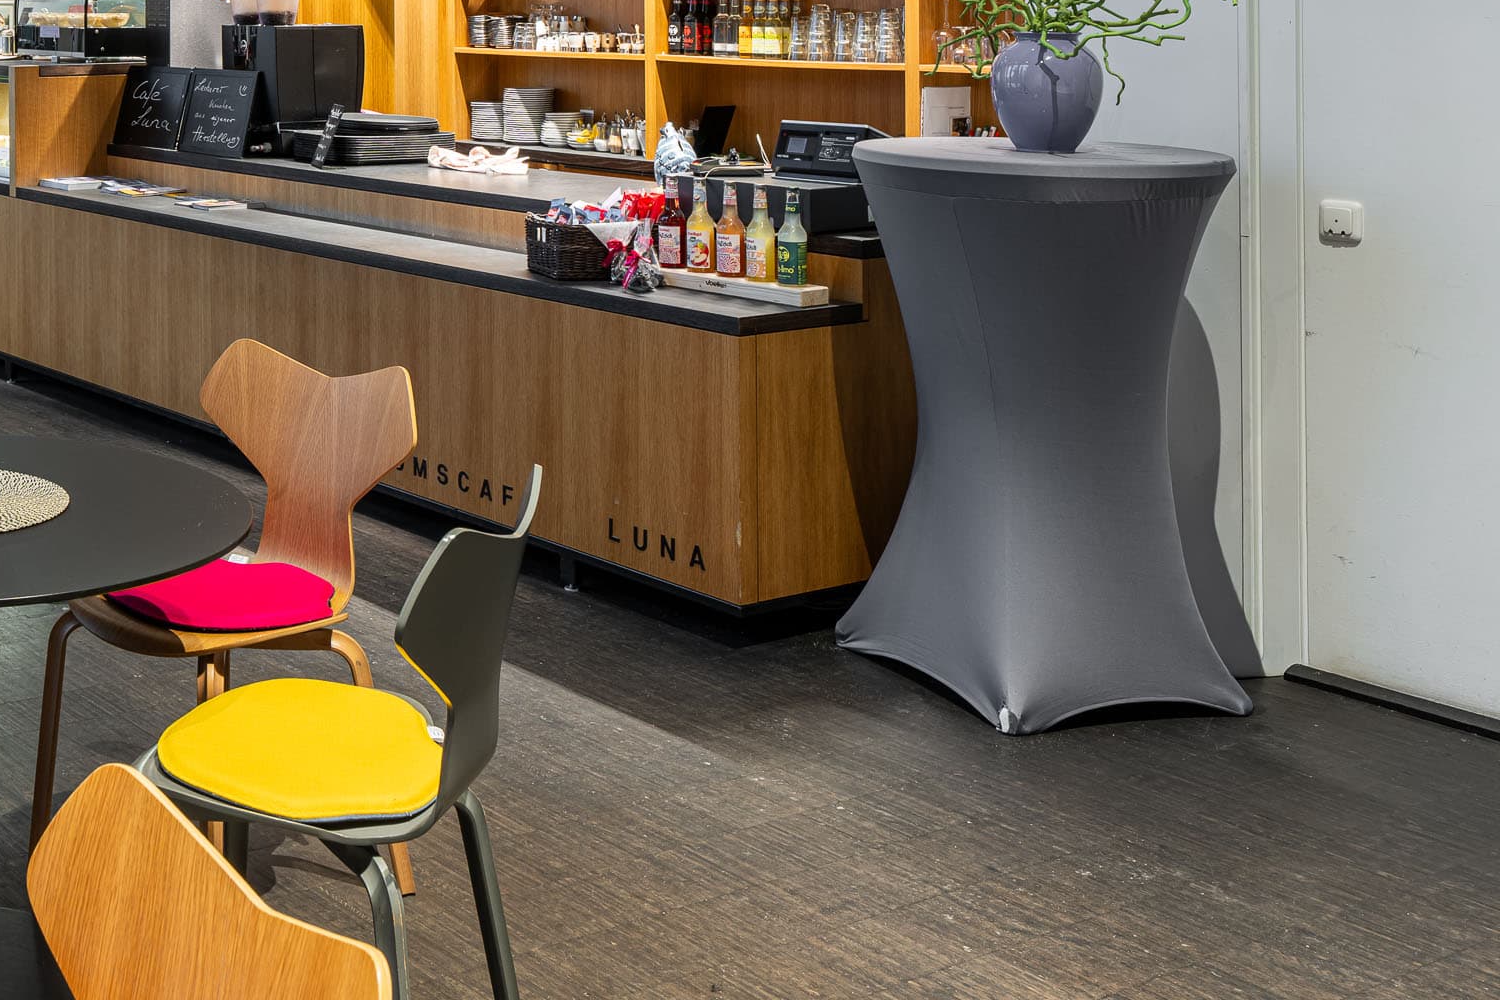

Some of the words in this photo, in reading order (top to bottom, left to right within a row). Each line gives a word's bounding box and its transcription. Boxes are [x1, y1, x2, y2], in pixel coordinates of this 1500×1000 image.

[132, 78, 169, 108] Café
[131, 106, 172, 132] Luna
[192, 124, 241, 149] Herstellung
[396, 456, 514, 506] MSCAF
[608, 518, 706, 571] LUNA
